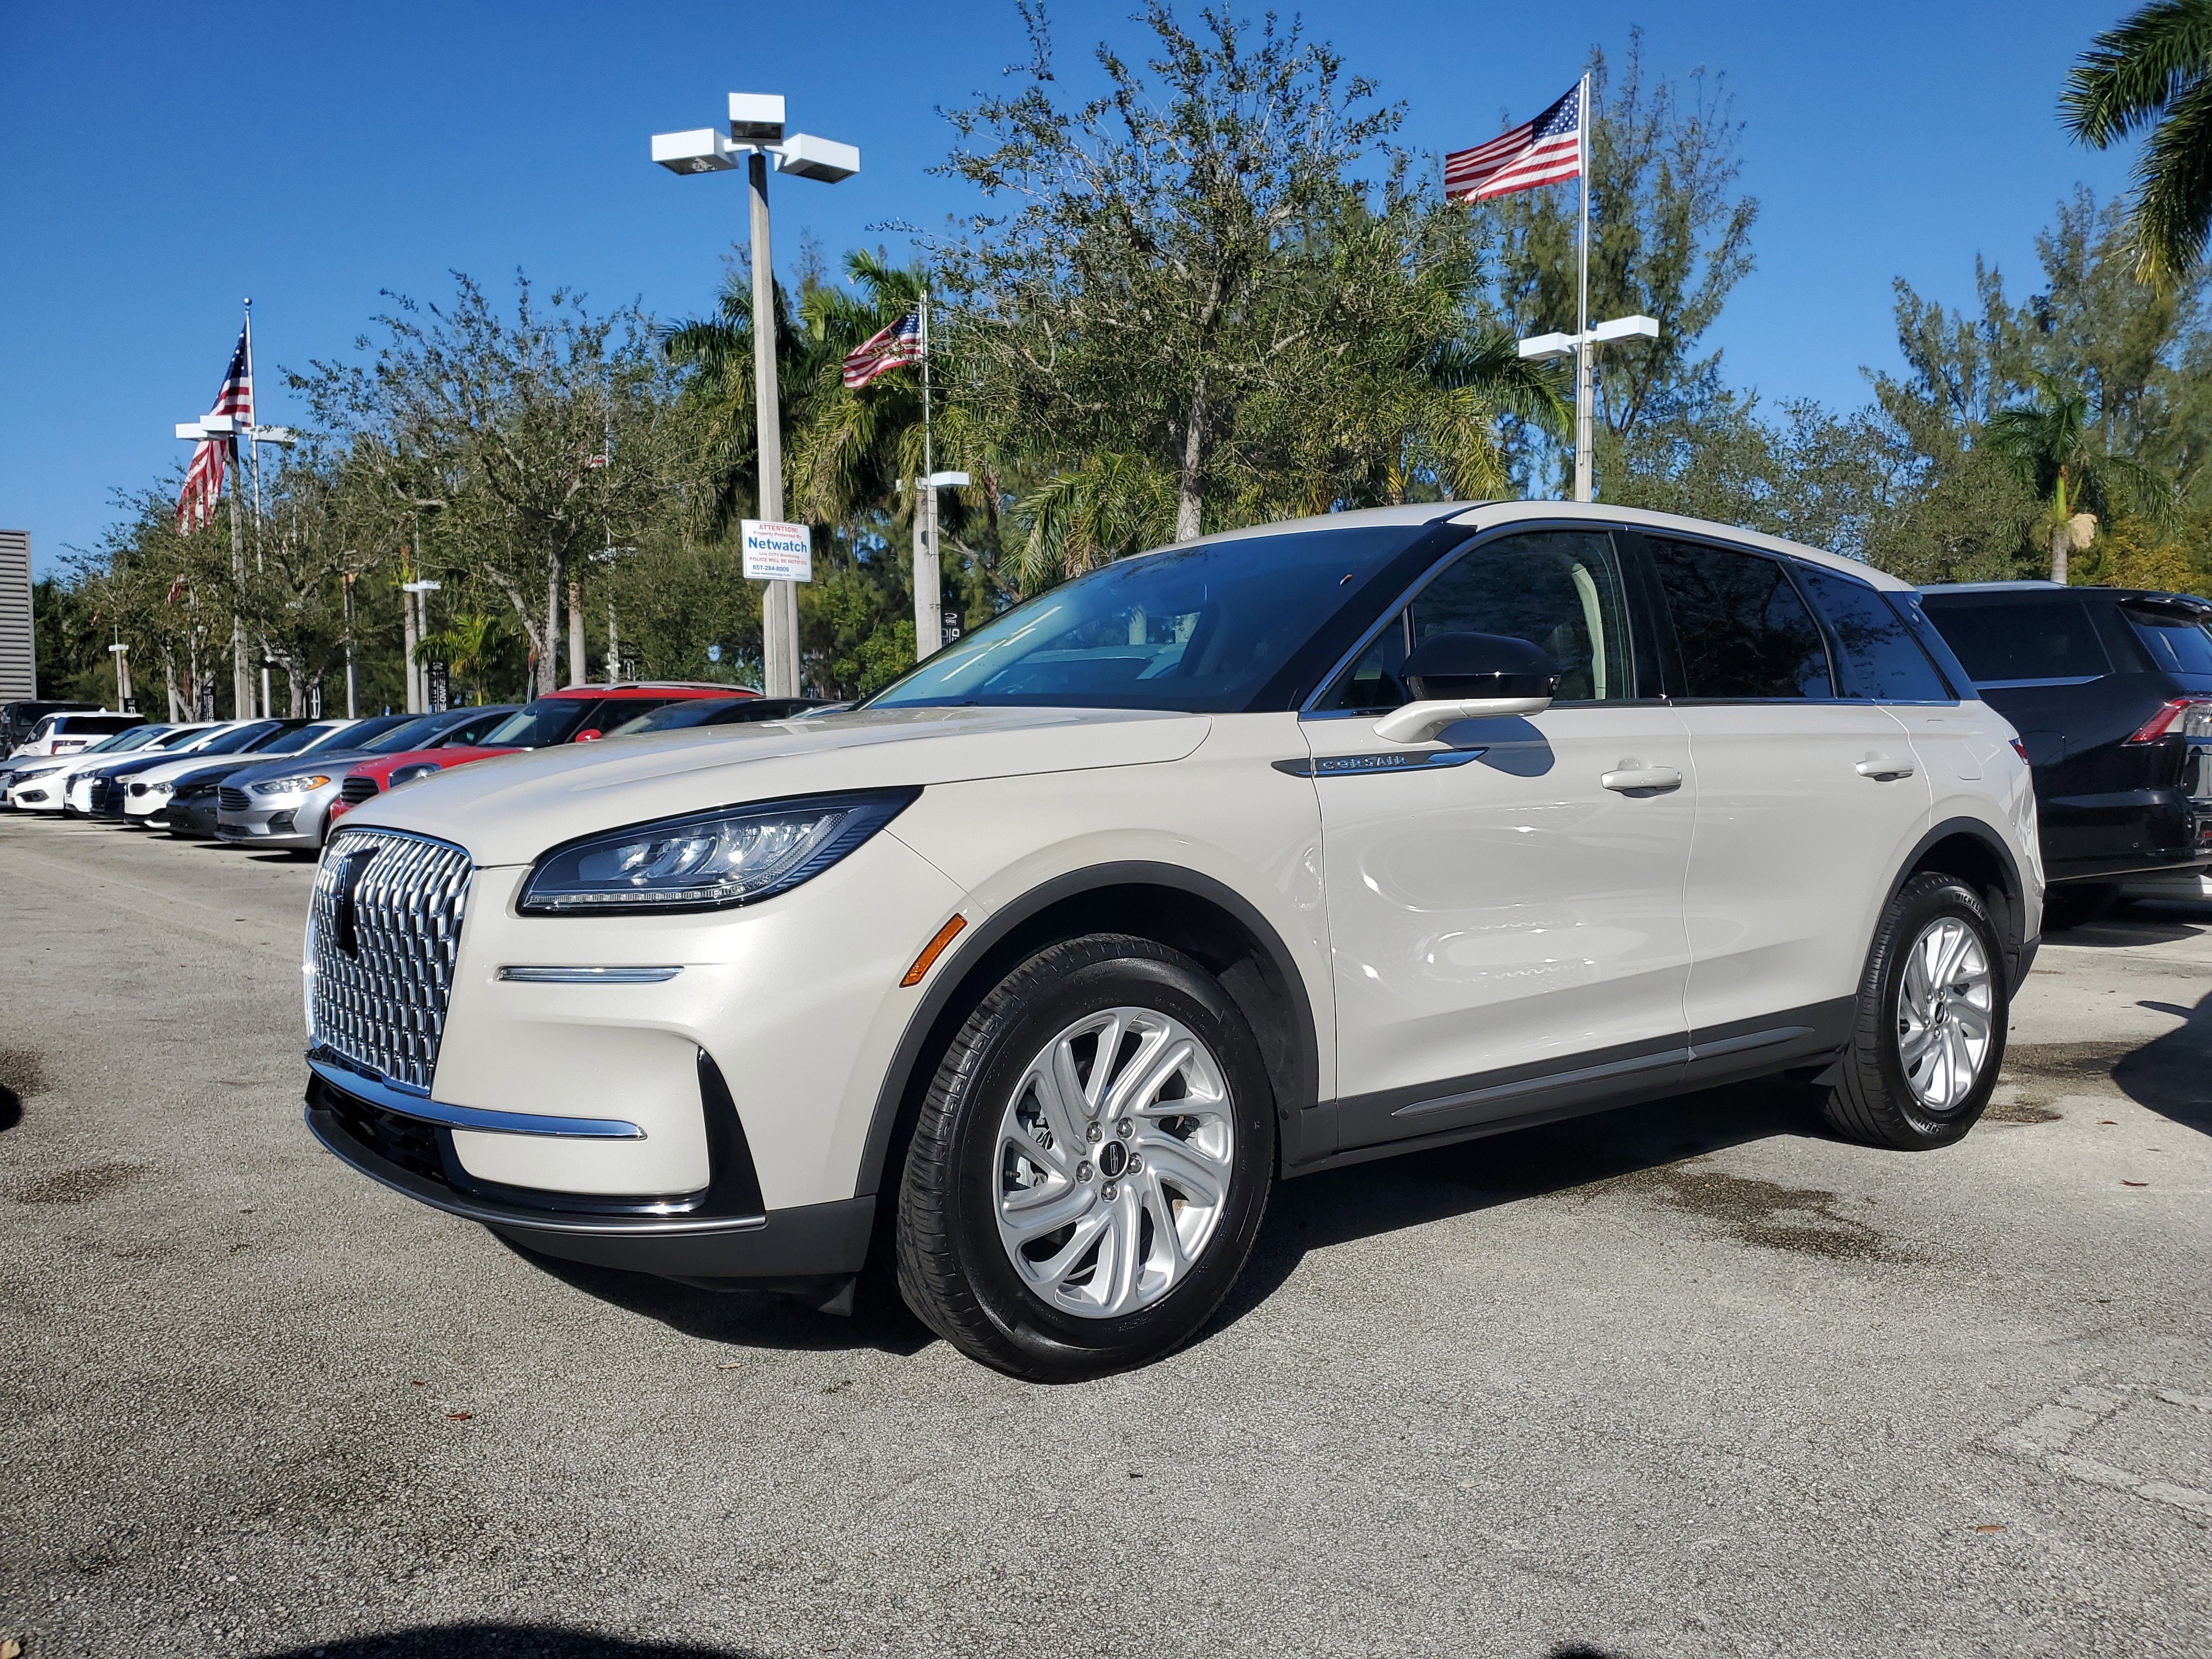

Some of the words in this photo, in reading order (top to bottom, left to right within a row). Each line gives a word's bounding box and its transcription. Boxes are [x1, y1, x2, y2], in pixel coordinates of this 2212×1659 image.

[748, 537, 807, 553] Netwatch
[1323, 755, 1406, 770] CORSAIR
[1954, 893, 1985, 918] MICHELIN
